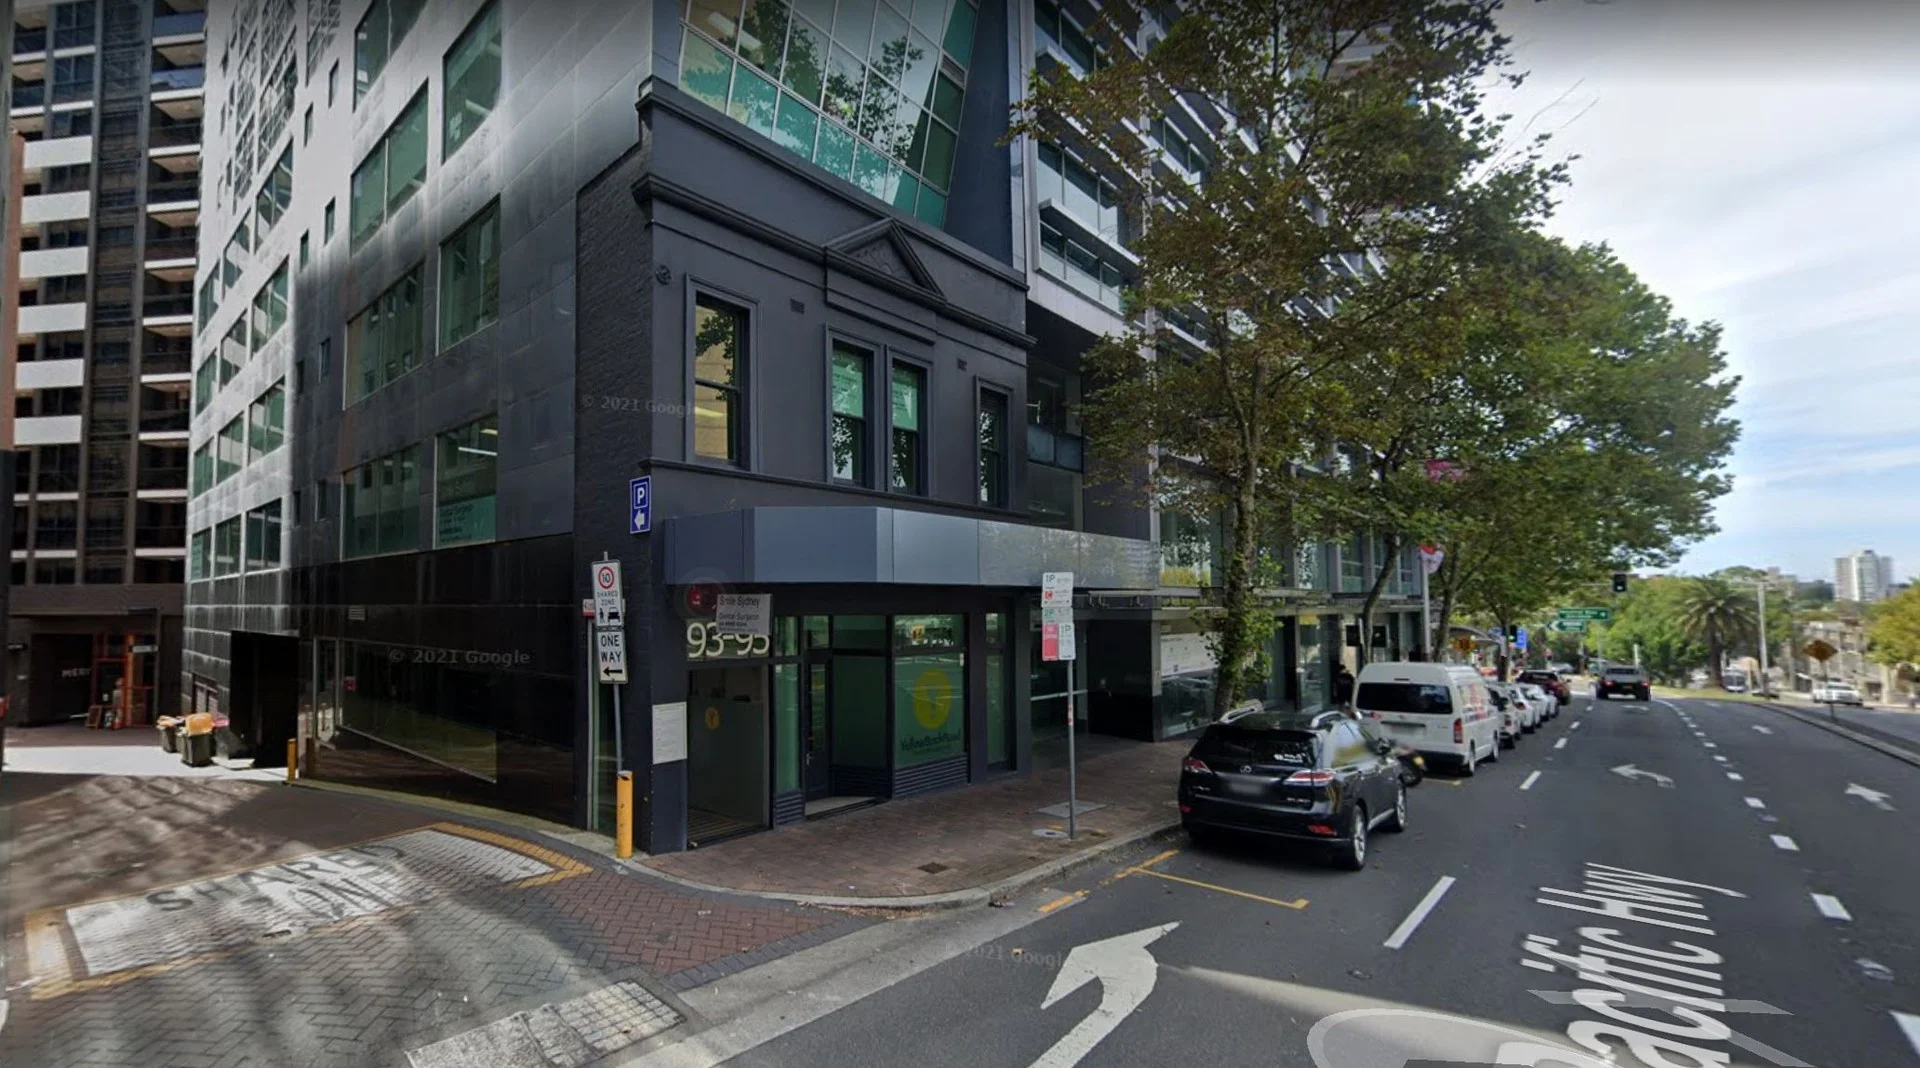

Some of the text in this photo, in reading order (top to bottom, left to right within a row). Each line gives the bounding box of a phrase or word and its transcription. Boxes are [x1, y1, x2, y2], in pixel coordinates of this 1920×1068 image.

[636, 487, 645, 504] P
[601, 572, 611, 583] 10
[596, 590, 619, 599] SHARED
[600, 598, 616, 606] ZONE
[737, 595, 760, 609] Sydney
[600, 634, 620, 648] ONE
[686, 621, 770, 658] 93-95
[600, 651, 622, 663] WAY
[146, 844, 405, 912] SHARED
[1536, 861, 1750, 936] Hwy
